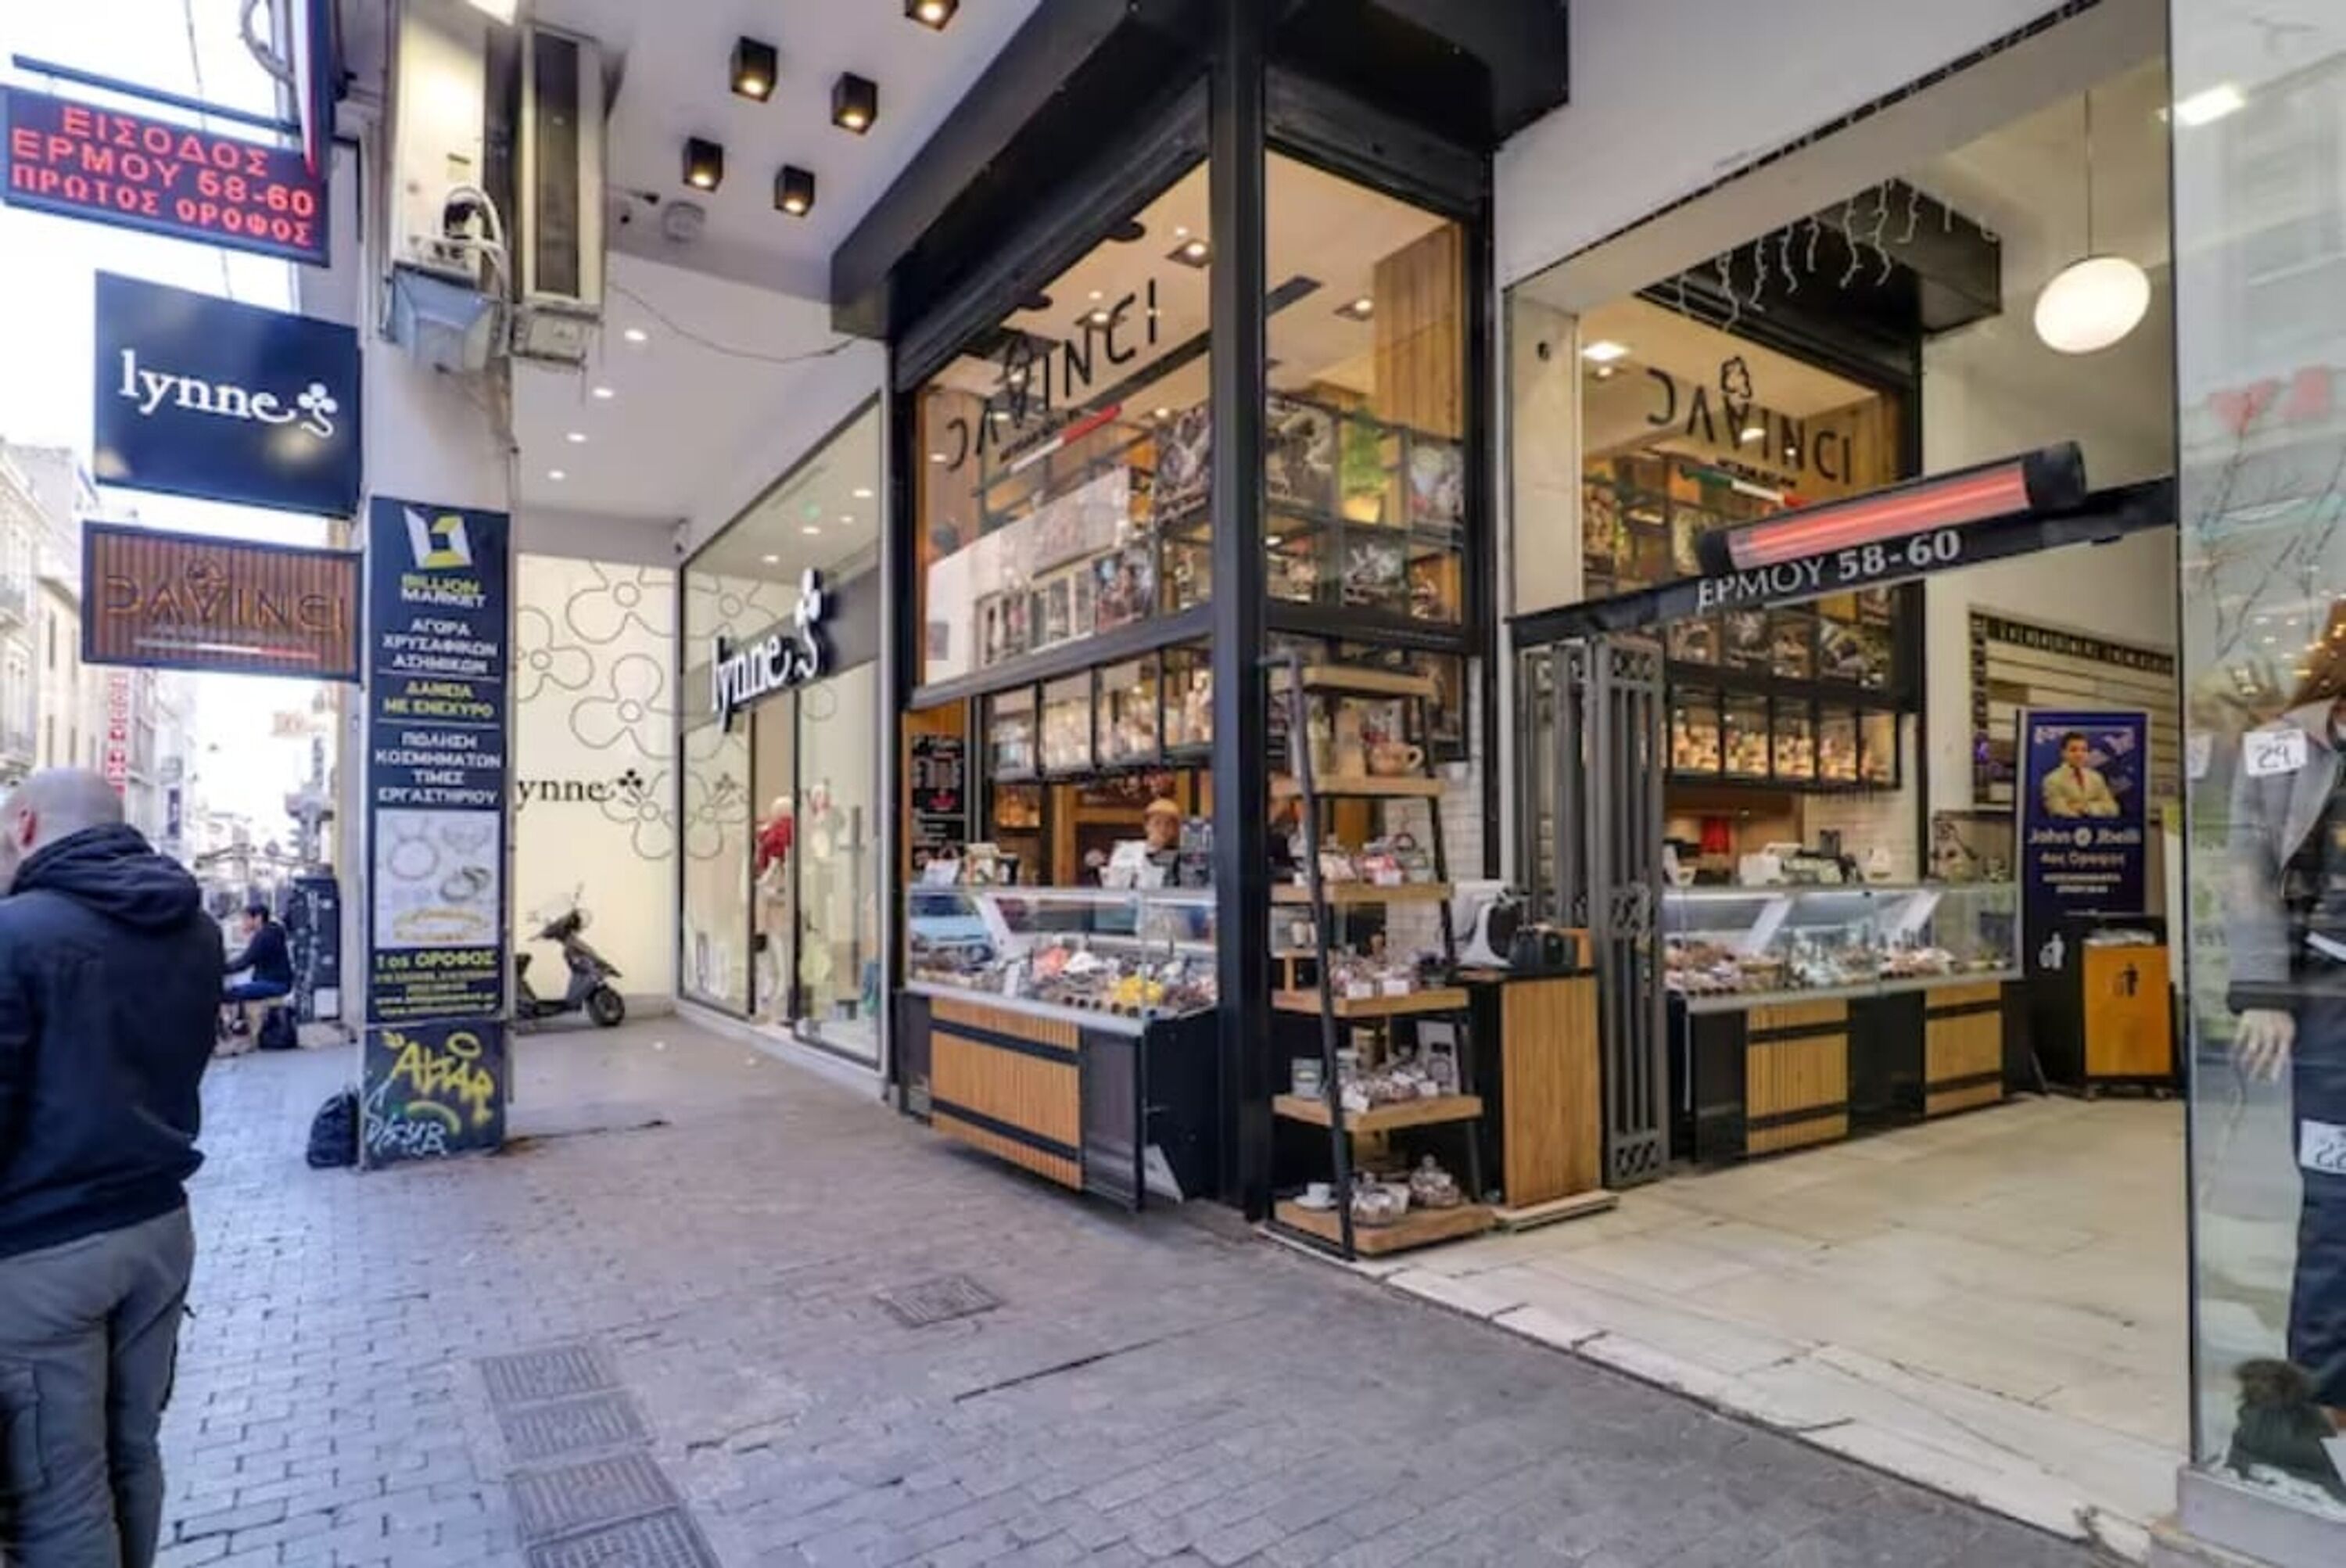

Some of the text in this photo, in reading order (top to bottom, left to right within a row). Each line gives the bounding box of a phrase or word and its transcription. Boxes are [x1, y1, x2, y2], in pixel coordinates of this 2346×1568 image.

[11, 127, 181, 188] ΕΡΜΟΥ
[63, 106, 269, 178] ΕΙΣΟΔΟΣ
[12, 163, 312, 248] ΠΡΩΤΟΣ ΟΡΟΦΟΣ
[118, 348, 298, 423] lynne
[1698, 529, 1960, 608] ΕΡΜΟΥ 58-60
[410, 618, 471, 637] ΑΓΟΡΑ
[711, 632, 790, 734] lynne
[515, 778, 616, 811] ynne
